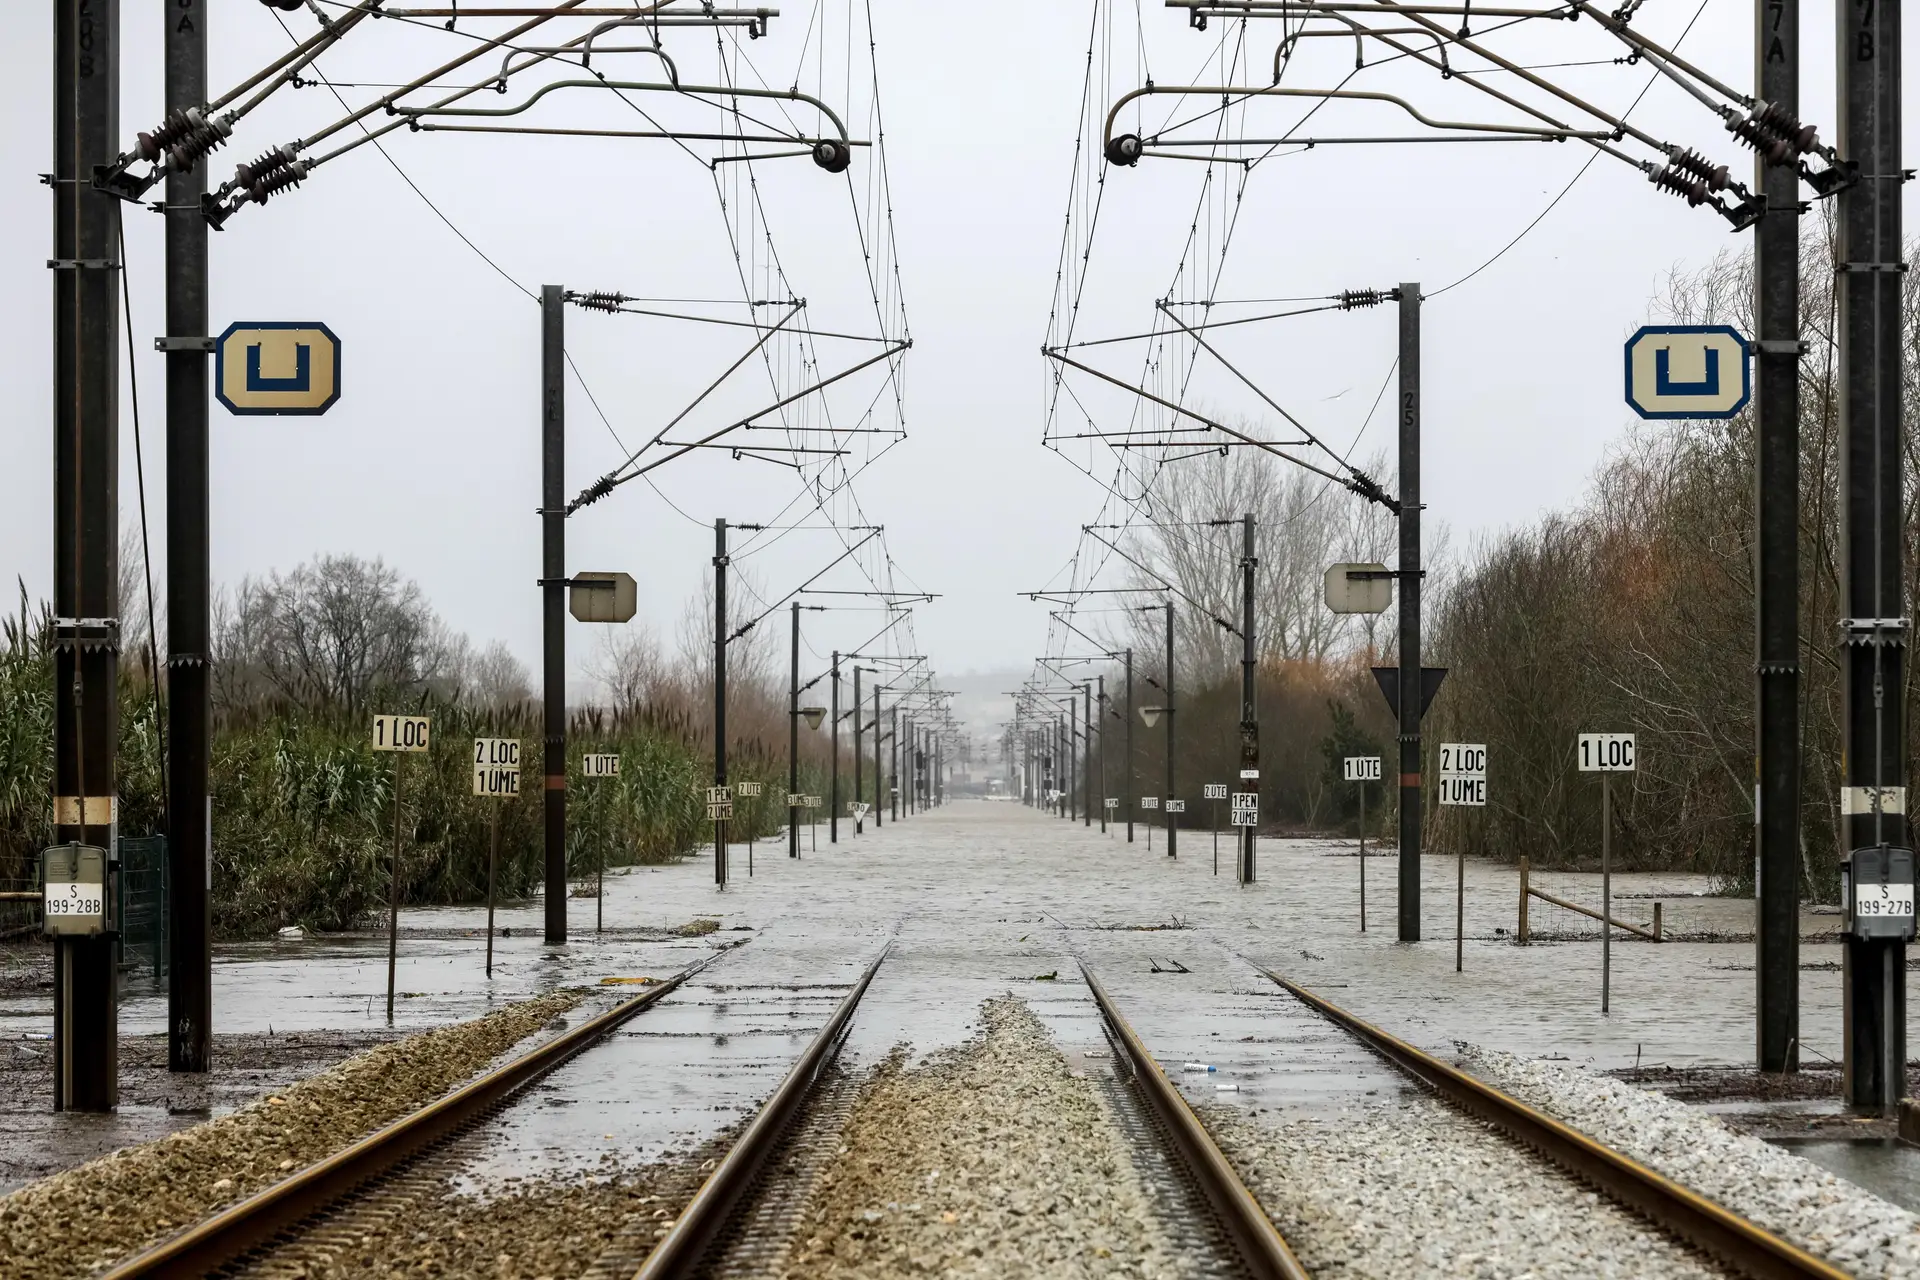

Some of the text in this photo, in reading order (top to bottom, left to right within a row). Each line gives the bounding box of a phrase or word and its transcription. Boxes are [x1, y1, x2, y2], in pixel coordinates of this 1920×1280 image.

[376, 719, 428, 747] 1 LOC
[475, 741, 518, 764] 2 LOC
[1581, 739, 1633, 767] 1 LOC
[584, 756, 618, 775] 1 UTE
[1442, 749, 1485, 772] 2 LOC
[1345, 759, 1380, 778] 1 UTE
[478, 770, 520, 793] 1 UME
[707, 789, 732, 801] 1 PEN
[740, 784, 761, 795] 2 UTE
[1205, 786, 1226, 797] 2 UTE
[1441, 780, 1485, 803] 1 UME
[1233, 795, 1257, 807] 1 PEN
[708, 806, 732, 818] 2 UME
[1233, 811, 1257, 824] 2 UME
[70, 884, 78, 898] S
[1881, 886, 1889, 899] S
[47, 899, 101, 914] 199-28B
[1858, 900, 1912, 915] 199-27B
